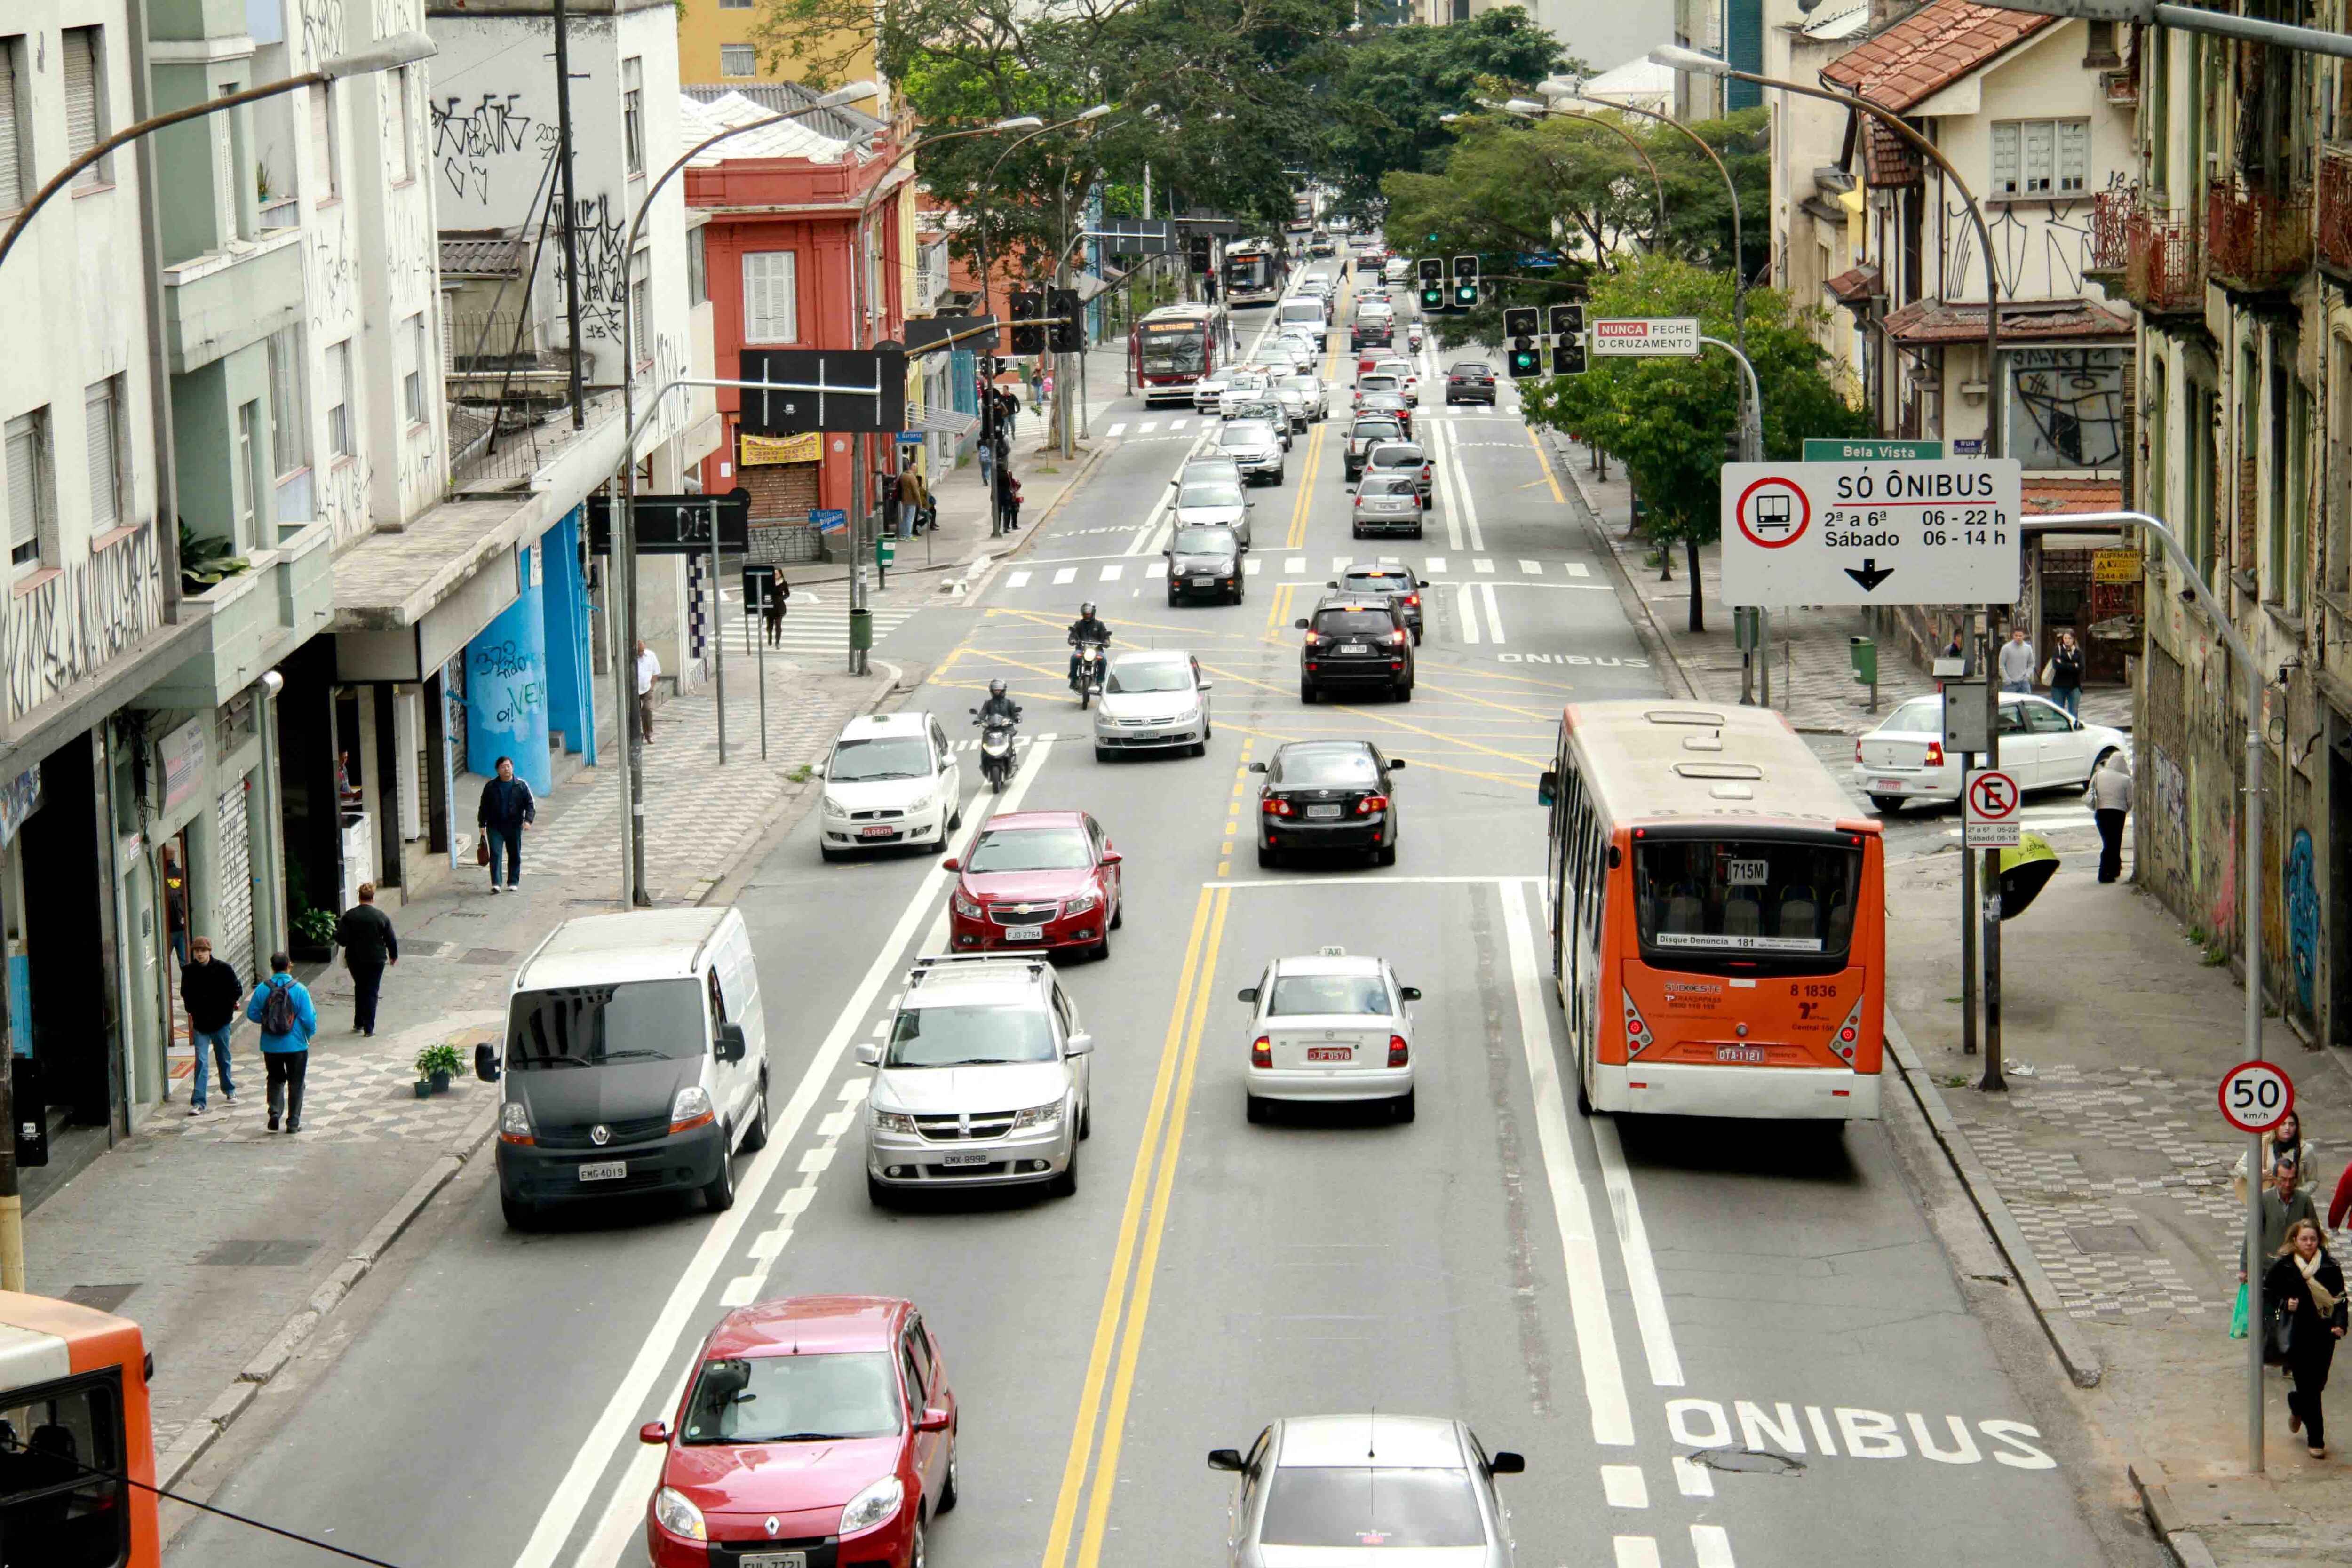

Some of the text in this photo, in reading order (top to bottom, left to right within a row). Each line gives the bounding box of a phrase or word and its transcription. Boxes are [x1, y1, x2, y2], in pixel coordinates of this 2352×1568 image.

[1602, 325, 1692, 334] NUNCA FECHE
[1598, 339, 1691, 348] O CRUZAMENTO
[1843, 446, 1915, 458] Bela Vista
[1837, 466, 1993, 499] SÓ ÔNIBUS
[1850, 515, 1860, 526] a
[1922, 510, 1945, 525] 06
[1964, 510, 1987, 525] 22
[1994, 510, 2005, 525] h
[1825, 531, 1899, 547] Sábado
[1923, 531, 1946, 546] 06
[1965, 530, 1986, 545] 14
[1994, 530, 2005, 545] h
[1498, 654, 1649, 667] ONIBUS
[1733, 864, 1764, 879] 715M
[1665, 984, 1722, 993] SUDOESTE
[1790, 985, 1836, 997] 8 1836
[2234, 1079, 2279, 1108] 50
[1665, 1398, 2057, 1470] ONIBUS
